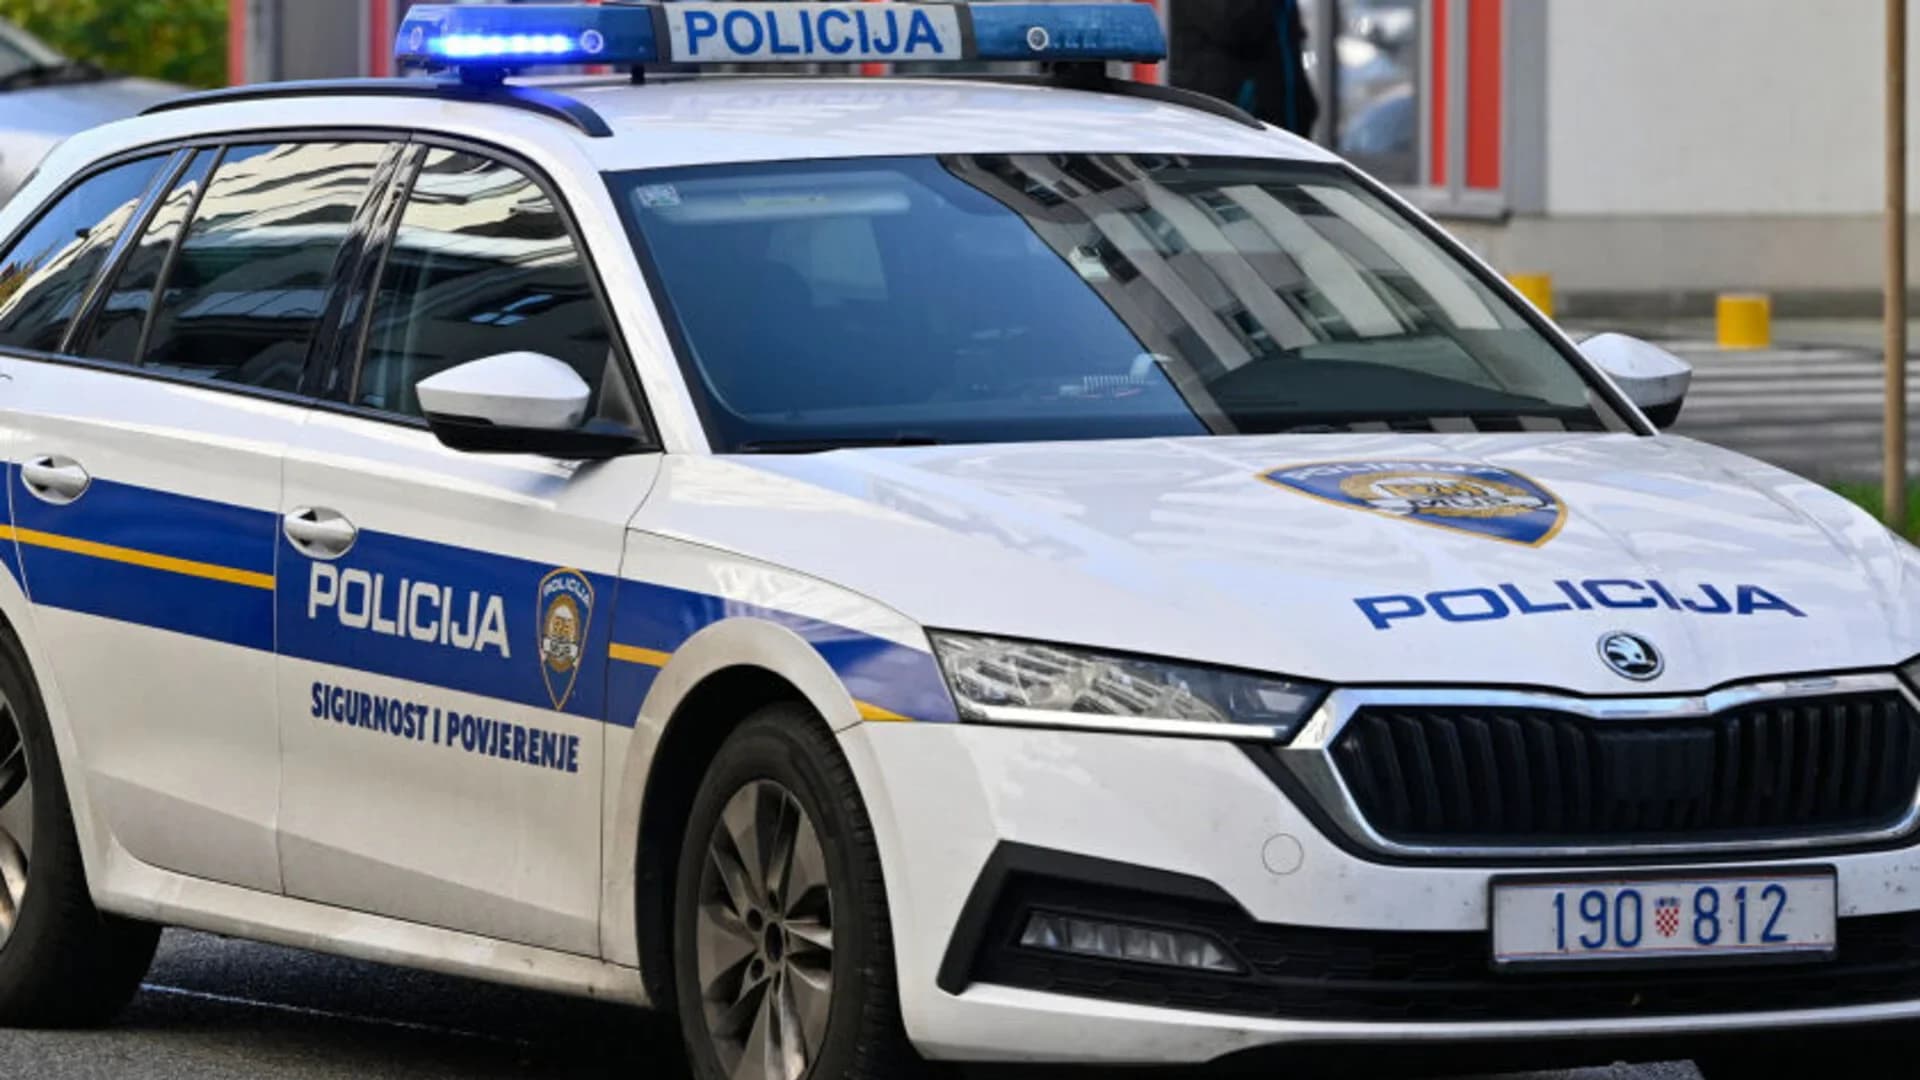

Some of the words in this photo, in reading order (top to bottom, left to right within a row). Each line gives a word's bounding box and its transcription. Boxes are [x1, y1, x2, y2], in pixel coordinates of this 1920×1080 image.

[682, 8, 945, 57] POLICIJA
[308, 561, 511, 658] POLICIJA
[1353, 579, 1808, 631] POLICIJA
[311, 681, 428, 741] SIGURNOST
[433, 708, 441, 744] I
[447, 711, 579, 773] POVJERENJE
[1552, 889, 1643, 951] 190
[1692, 883, 1788, 946] 812
